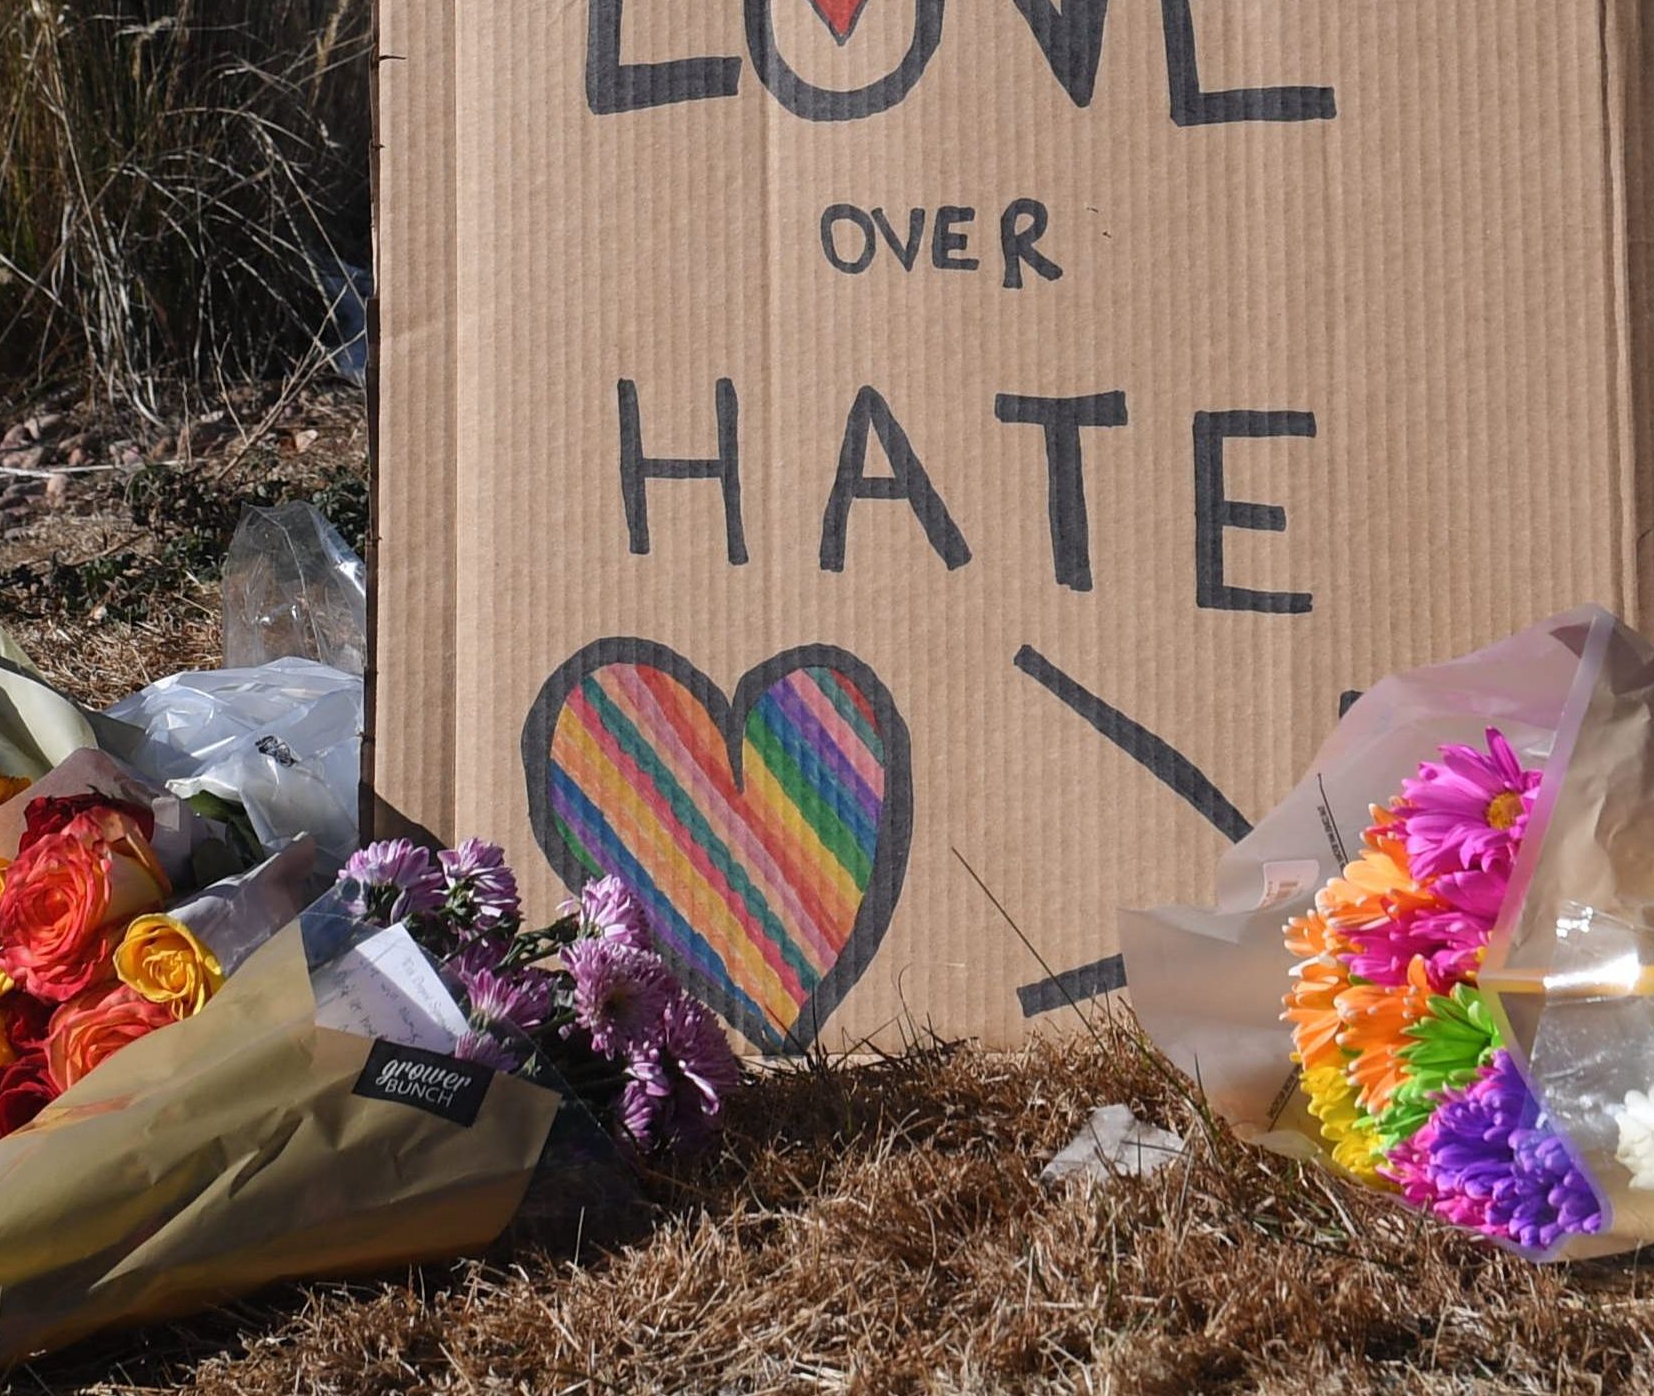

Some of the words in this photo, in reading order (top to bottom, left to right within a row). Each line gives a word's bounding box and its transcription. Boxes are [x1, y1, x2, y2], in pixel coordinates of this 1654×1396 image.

[819, 197, 1063, 290] OVER
[616, 377, 1317, 614] HATE
[376, 1059, 472, 1093] grower
[385, 1077, 456, 1108] BUNCH
